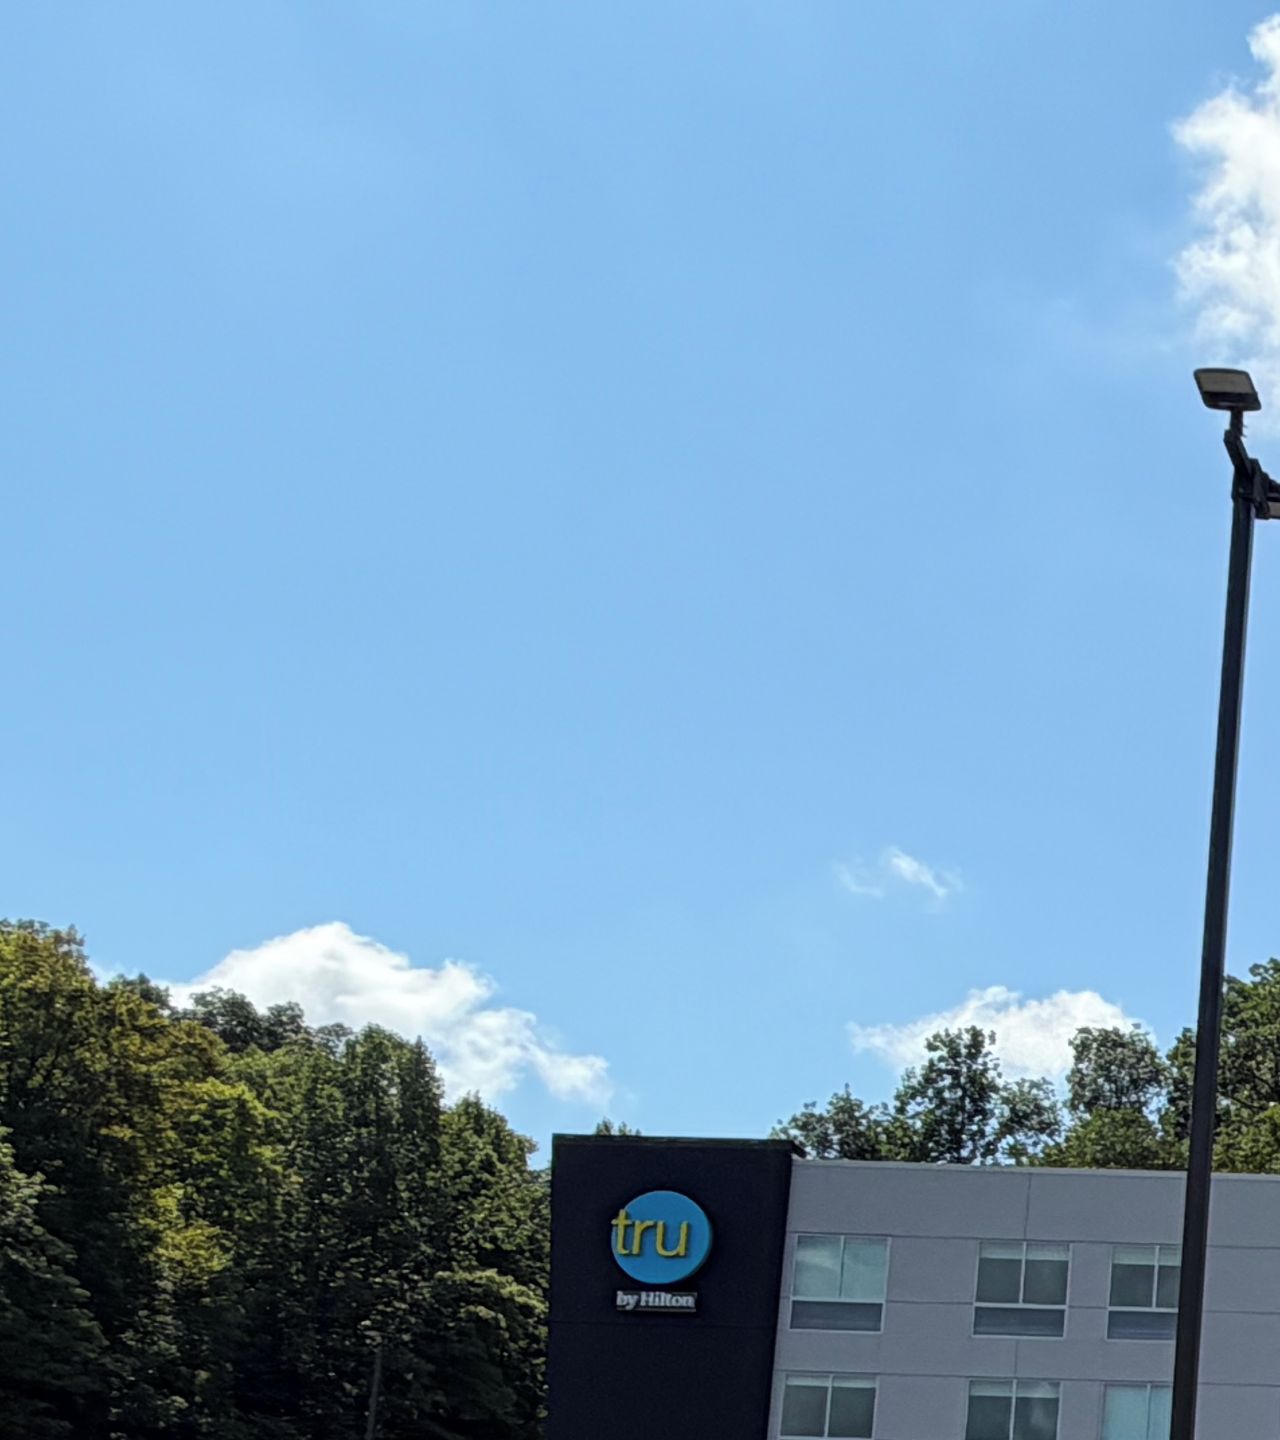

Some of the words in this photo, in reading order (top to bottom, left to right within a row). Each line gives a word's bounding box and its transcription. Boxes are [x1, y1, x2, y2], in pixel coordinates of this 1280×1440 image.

[611, 1209, 689, 1257] tru
[616, 1290, 638, 1310] by
[640, 1291, 695, 1308] Hilton
